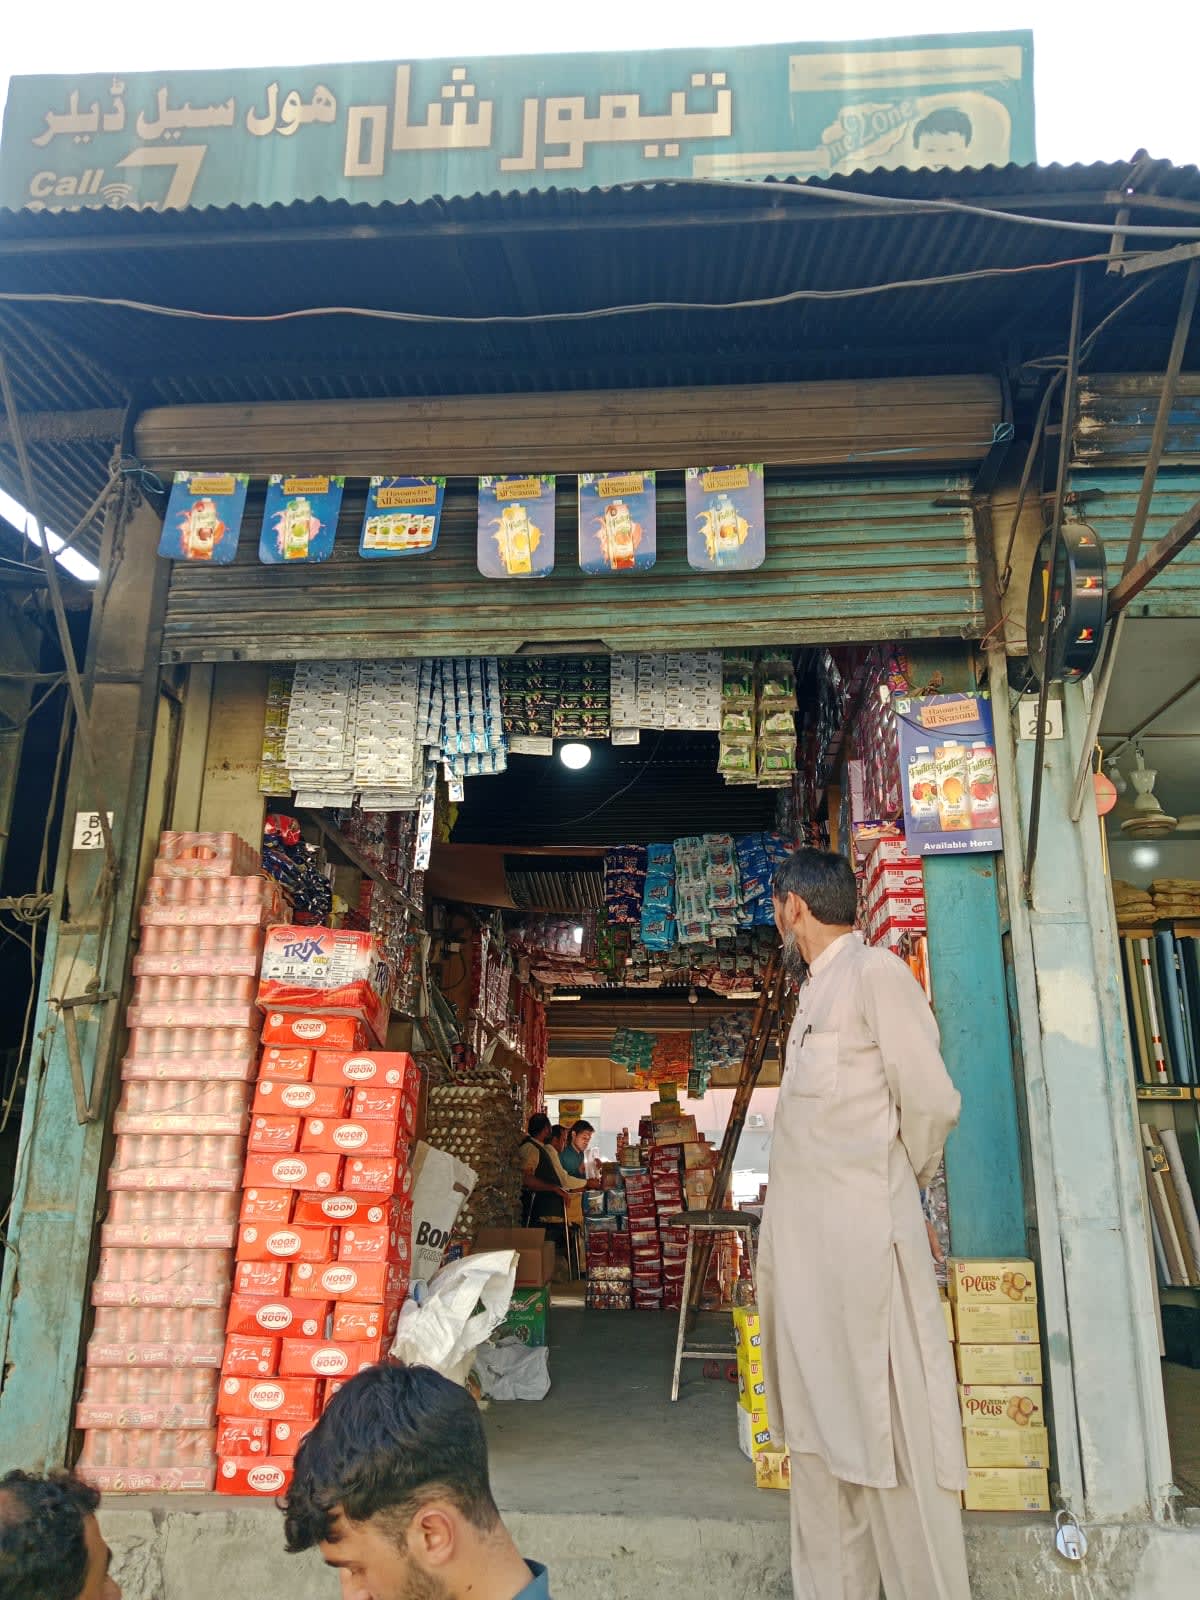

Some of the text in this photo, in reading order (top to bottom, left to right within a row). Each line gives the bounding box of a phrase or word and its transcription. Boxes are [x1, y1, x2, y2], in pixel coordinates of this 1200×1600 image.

[136, 86, 235, 141] سیل
[29, 168, 105, 198] Call
[938, 712, 976, 722] Seasons
[89, 815, 100, 828] B
[82, 831, 102, 846] 21
[923, 840, 993, 850] Available Here
[961, 1275, 997, 1292] Plus
[966, 1398, 1003, 1416] Plus
